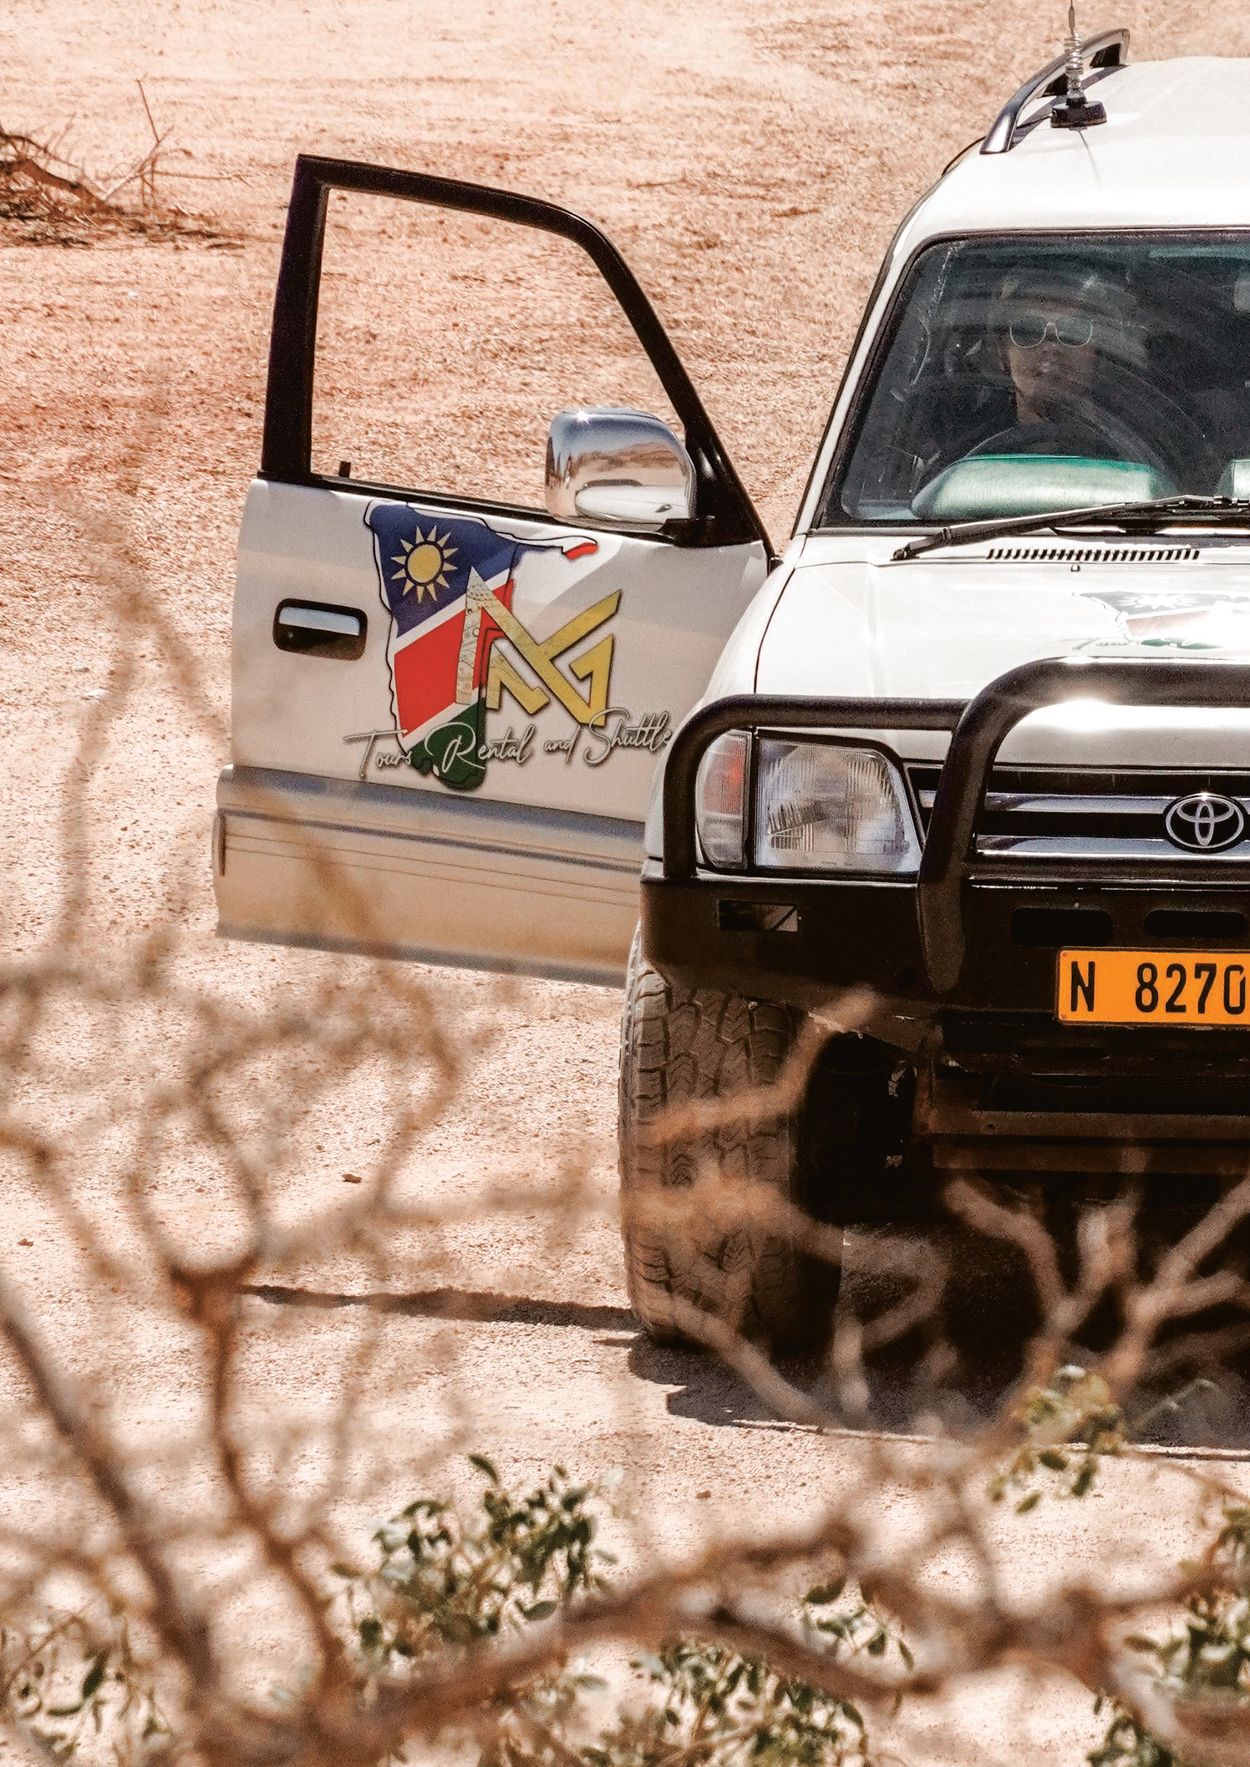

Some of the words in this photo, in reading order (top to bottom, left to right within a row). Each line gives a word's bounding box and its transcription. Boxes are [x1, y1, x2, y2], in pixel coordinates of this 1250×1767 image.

[343, 727, 412, 779] Tours
[424, 718, 533, 775] Rental
[542, 724, 581, 766] and
[1070, 961, 1096, 1012] N
[1134, 962, 1246, 1016] 8270
